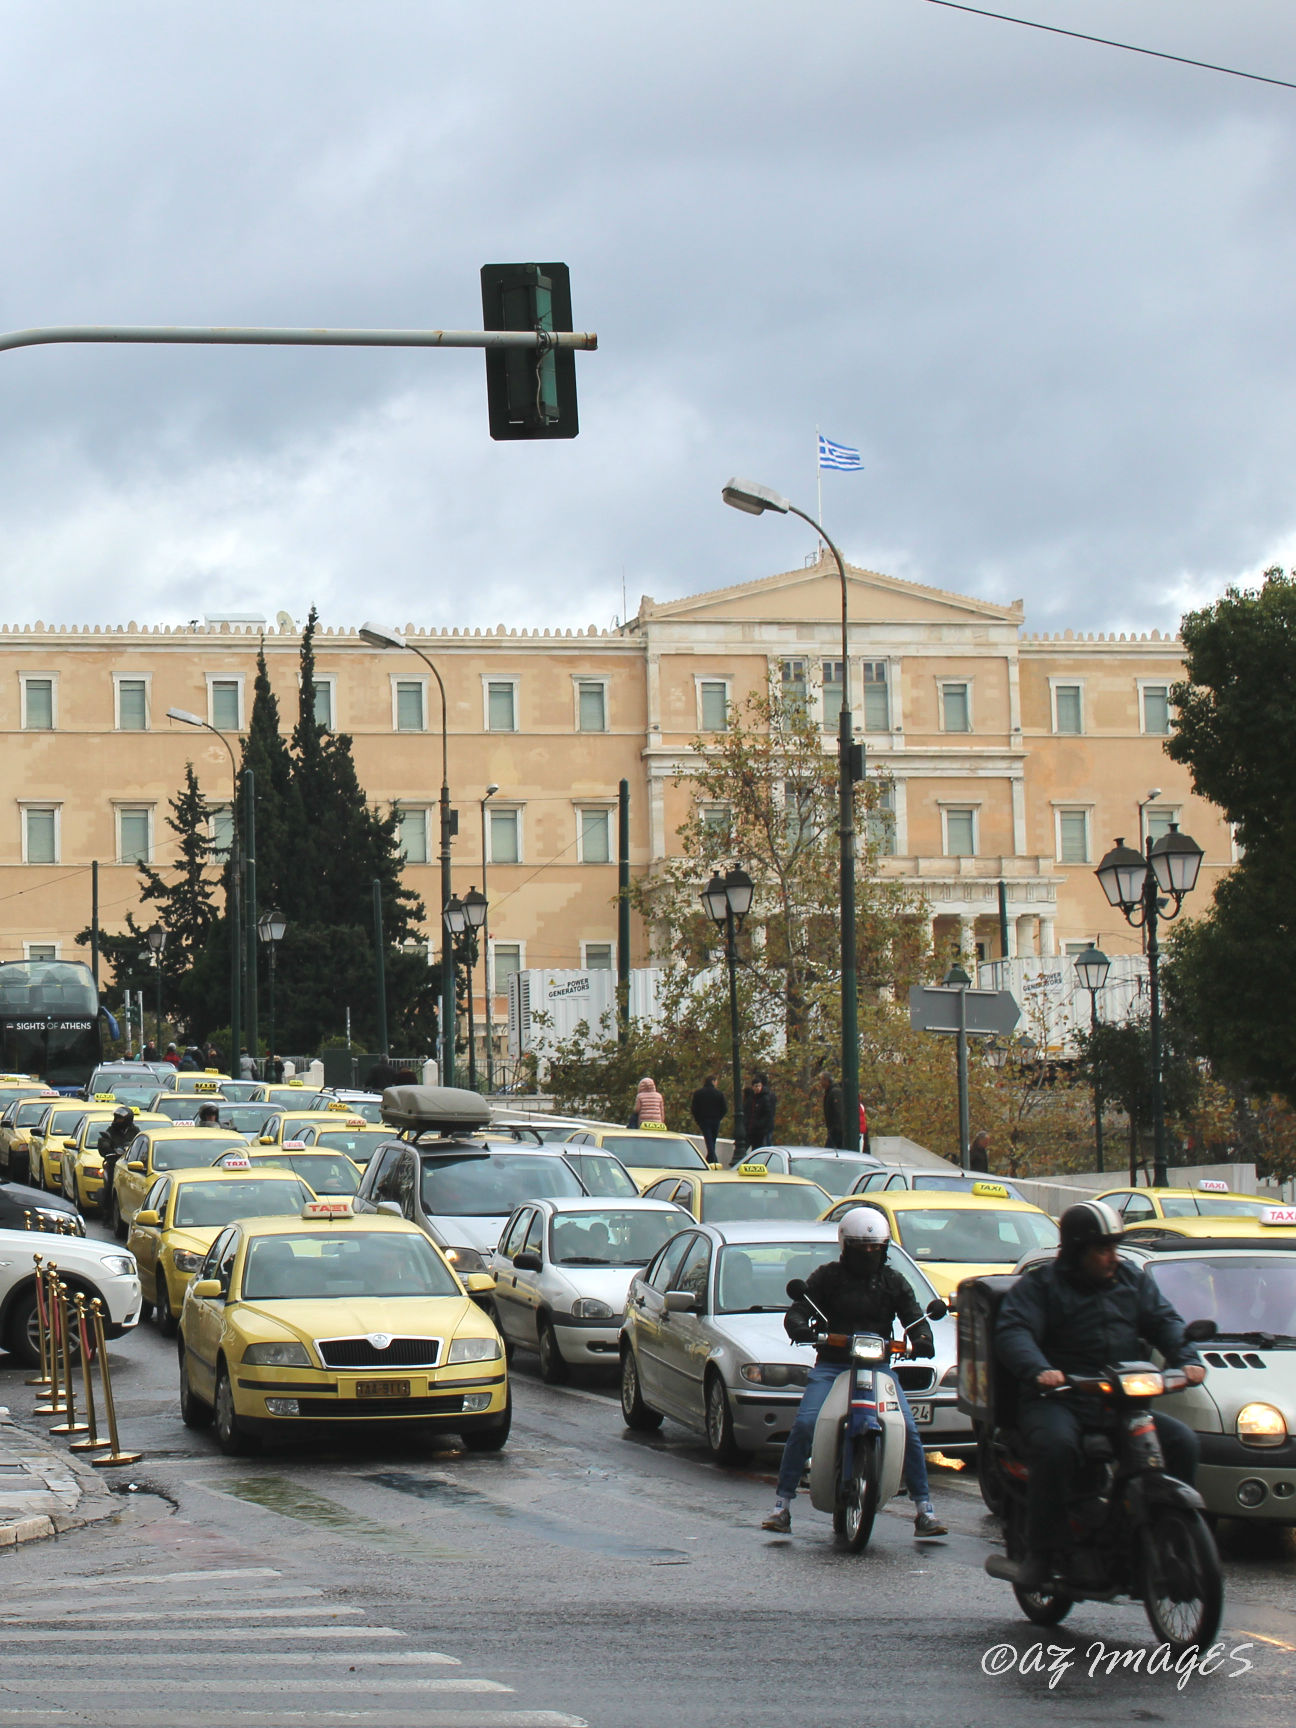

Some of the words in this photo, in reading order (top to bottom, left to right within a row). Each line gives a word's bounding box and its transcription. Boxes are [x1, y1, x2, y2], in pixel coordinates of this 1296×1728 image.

[567, 978, 589, 988] POWER
[548, 984, 590, 998] GENERATORS
[16, 1022, 46, 1030] SIGHTS
[47, 1022, 60, 1030] OF
[60, 1022, 92, 1030] ATHENS
[744, 1165, 766, 1173] TAXI
[980, 1184, 1002, 1192] TAXI
[1204, 1182, 1225, 1190] TAXI
